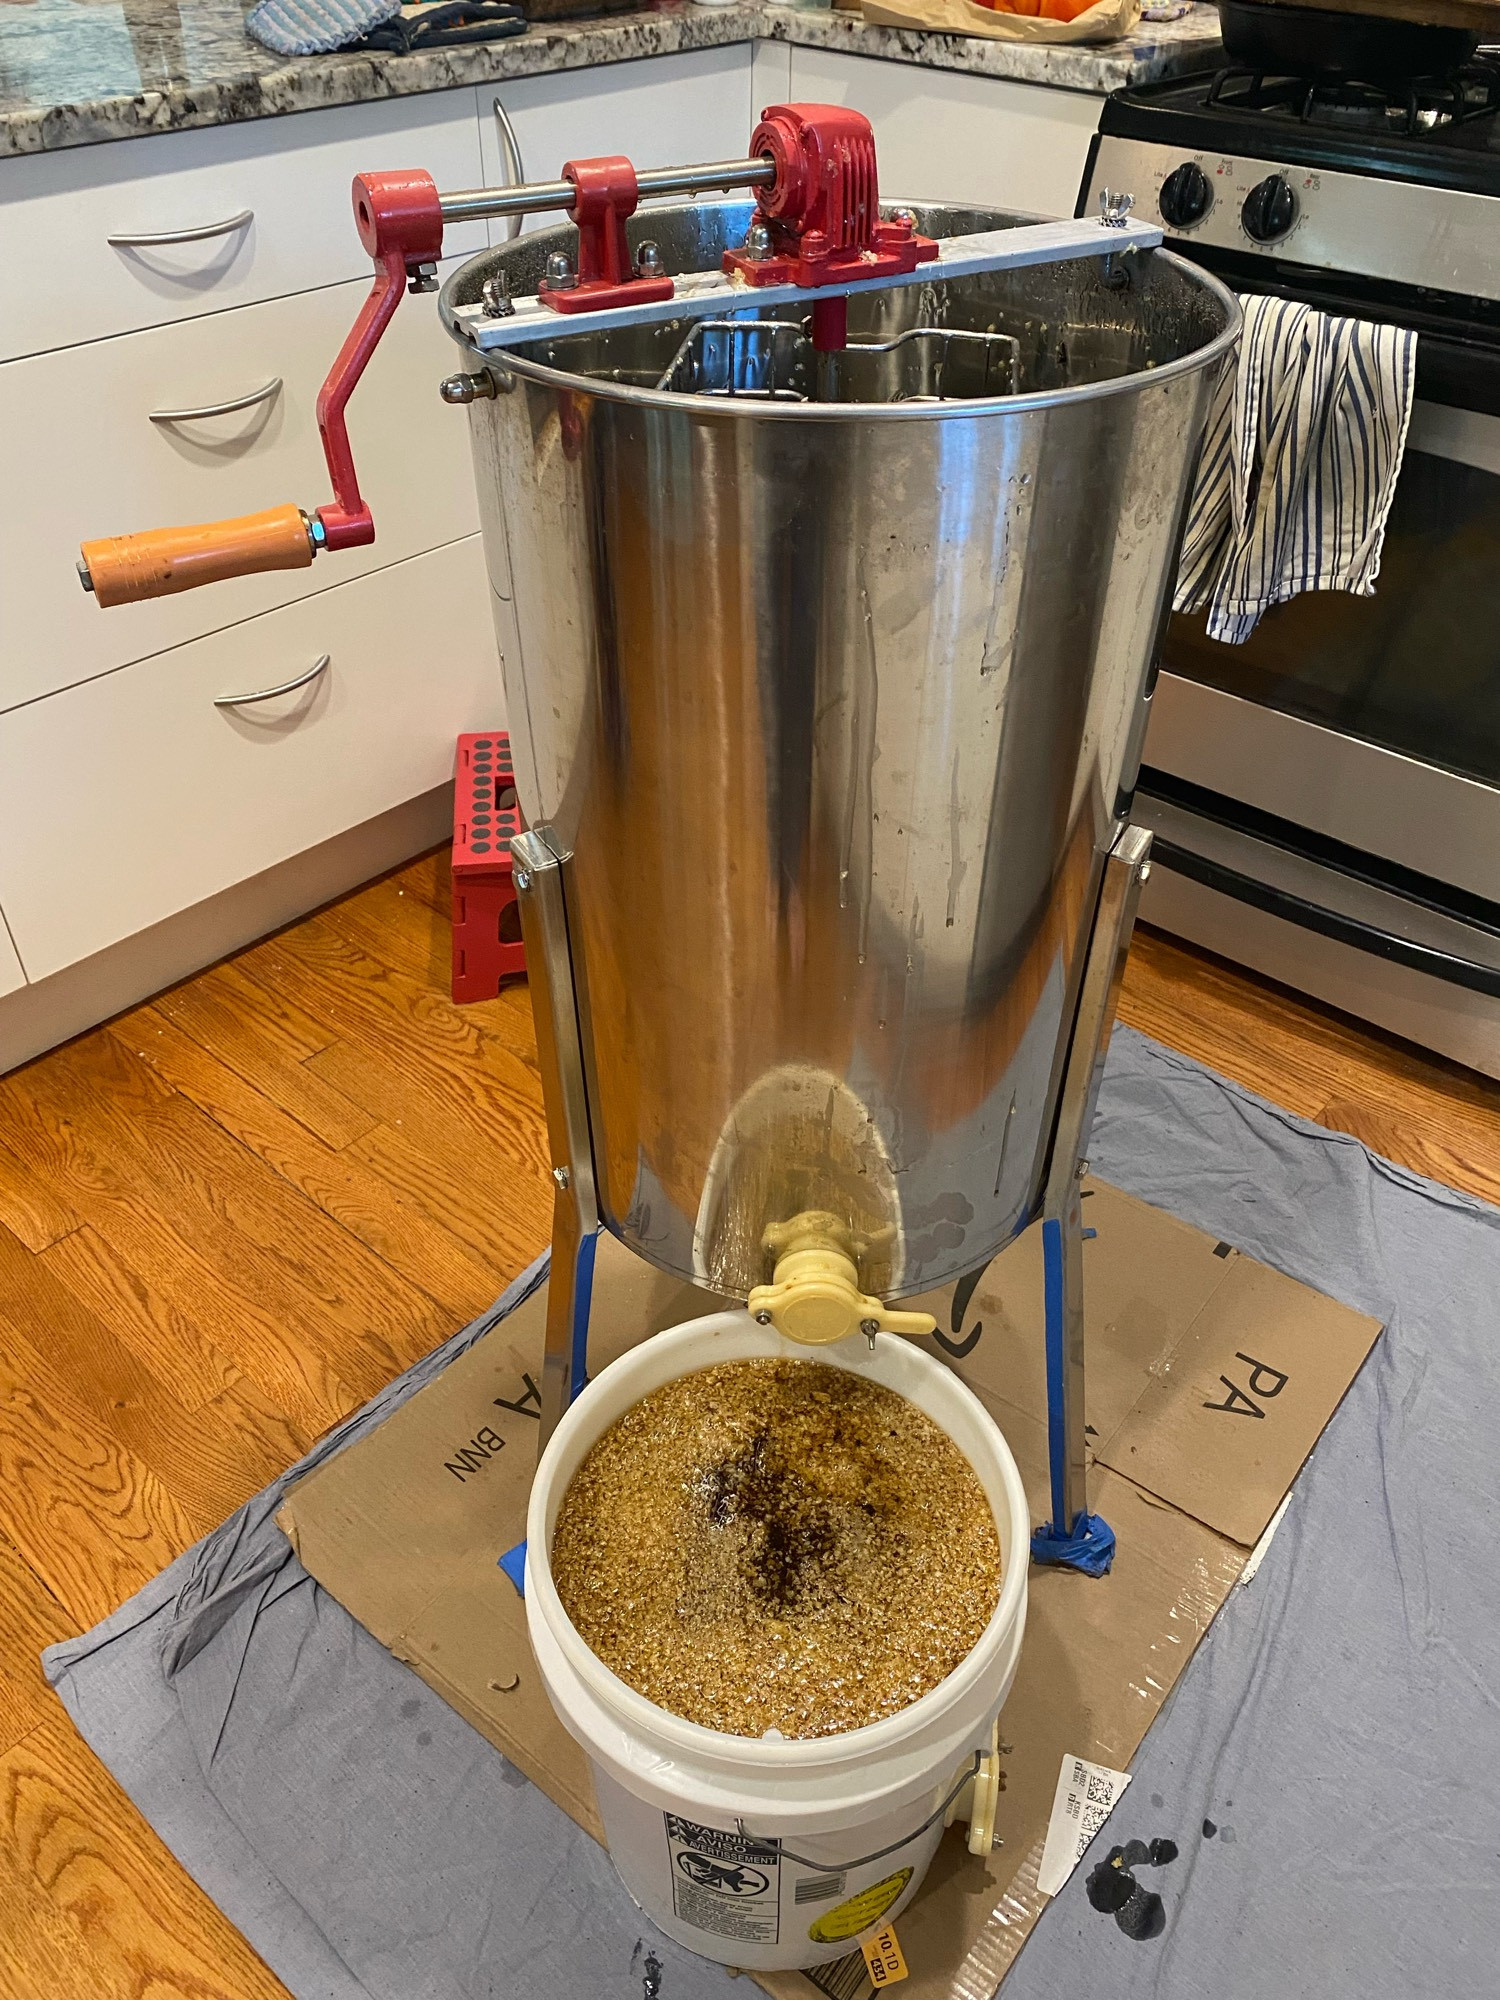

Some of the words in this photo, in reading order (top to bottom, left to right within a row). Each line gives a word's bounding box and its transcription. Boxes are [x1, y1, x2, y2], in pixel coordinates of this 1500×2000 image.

[1203, 1352, 1289, 1419] PA
[443, 1426, 506, 1482] BNN
[686, 1821, 754, 1846] WARNIN
[697, 1835, 747, 1853] AVISO
[690, 1841, 774, 1865] AVERTISSEMENT
[878, 1932, 899, 1970] 10.1D
